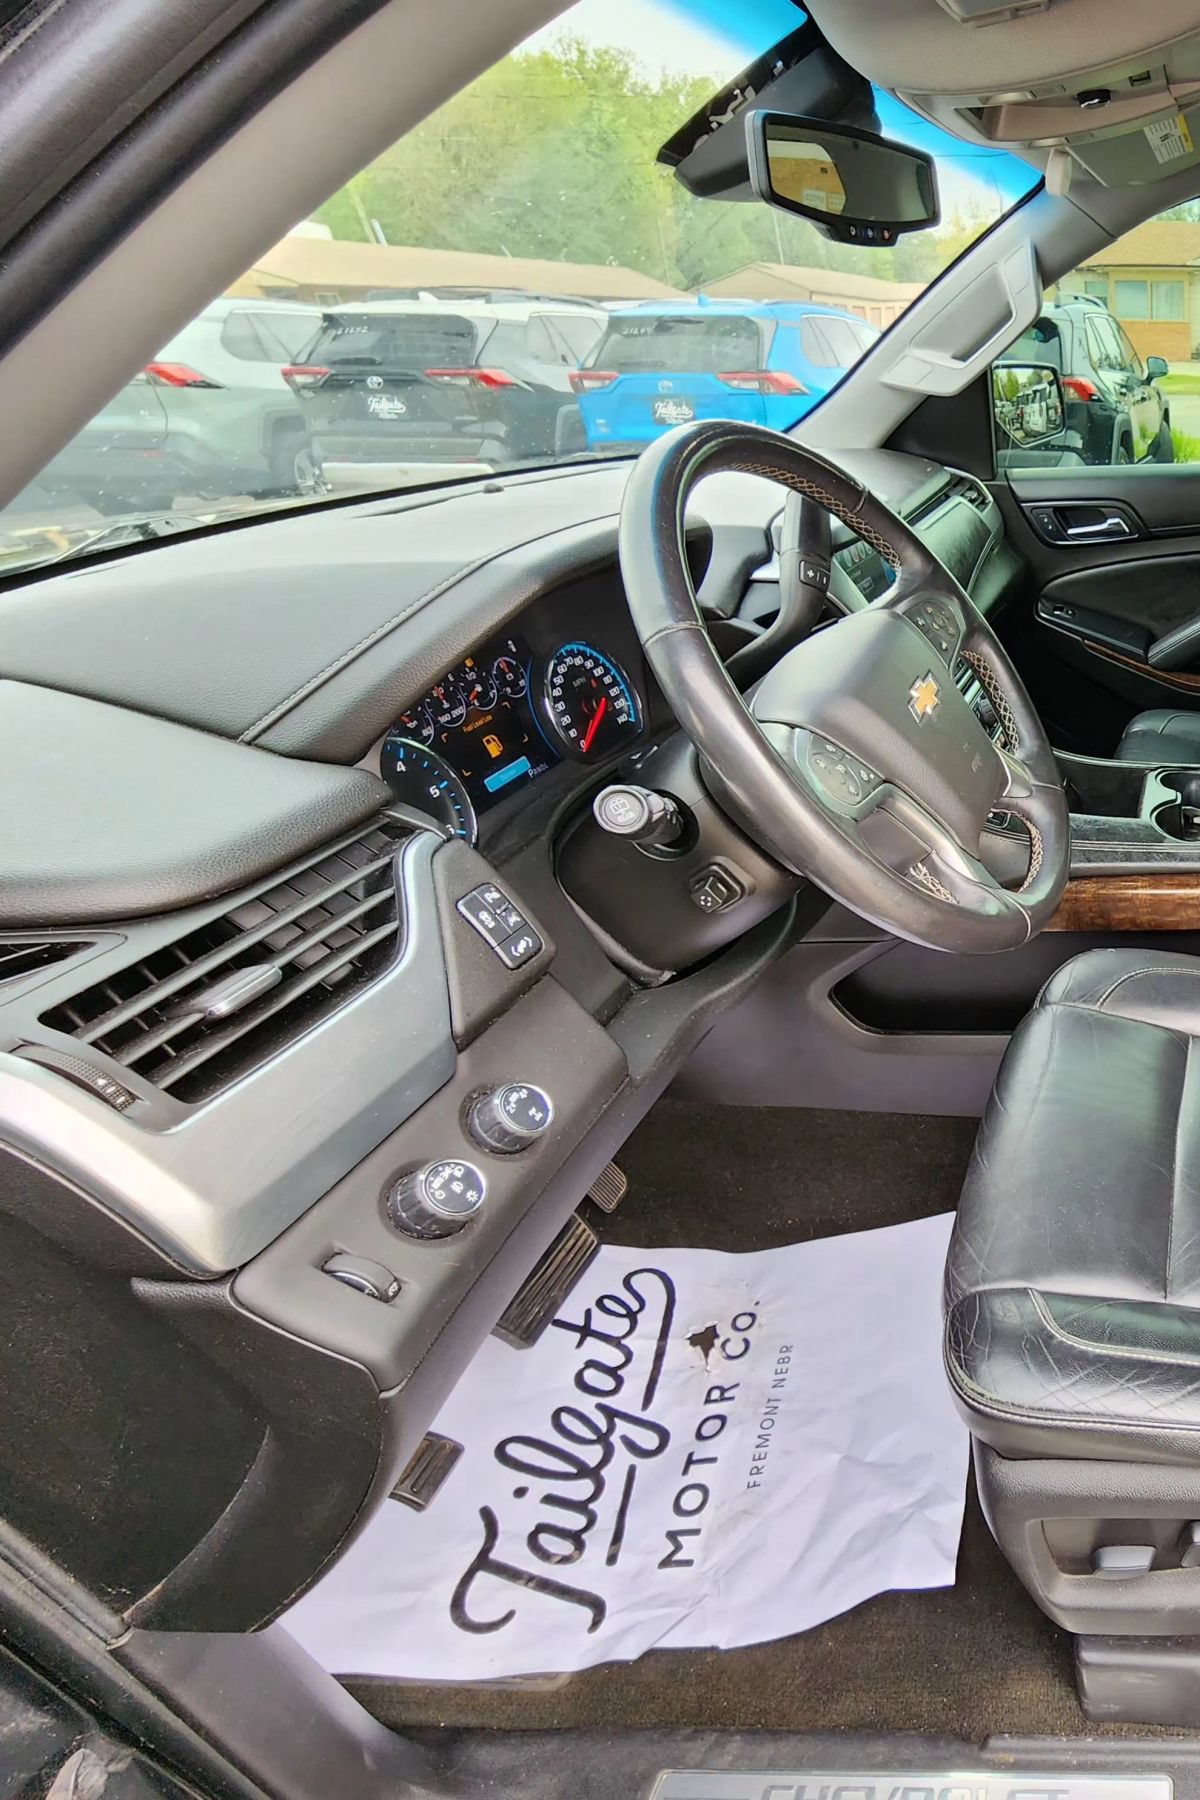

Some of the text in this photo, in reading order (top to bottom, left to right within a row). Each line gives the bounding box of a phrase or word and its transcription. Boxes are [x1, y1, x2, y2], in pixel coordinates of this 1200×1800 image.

[563, 657, 574, 667] 70
[573, 656, 584, 666] 80
[584, 659, 594, 669] 90
[557, 664, 567, 674] 60
[593, 666, 604, 677] 100
[465, 672, 477, 681] 1/2
[553, 675, 564, 686] 50
[552, 687, 562, 697] 40
[451, 706, 465, 718] 260
[555, 701, 566, 712] 30
[438, 713, 451, 723] 160
[560, 715, 571, 726] 20
[616, 713, 628, 725] 140
[568, 728, 578, 738] 10
[396, 761, 406, 772] 4
[429, 785, 440, 798] 5
[747, 1344, 793, 1489] FREMONT NEBR
[657, 1300, 761, 1569] MOTOR CO.
[450, 1268, 676, 1634] Tailgate
